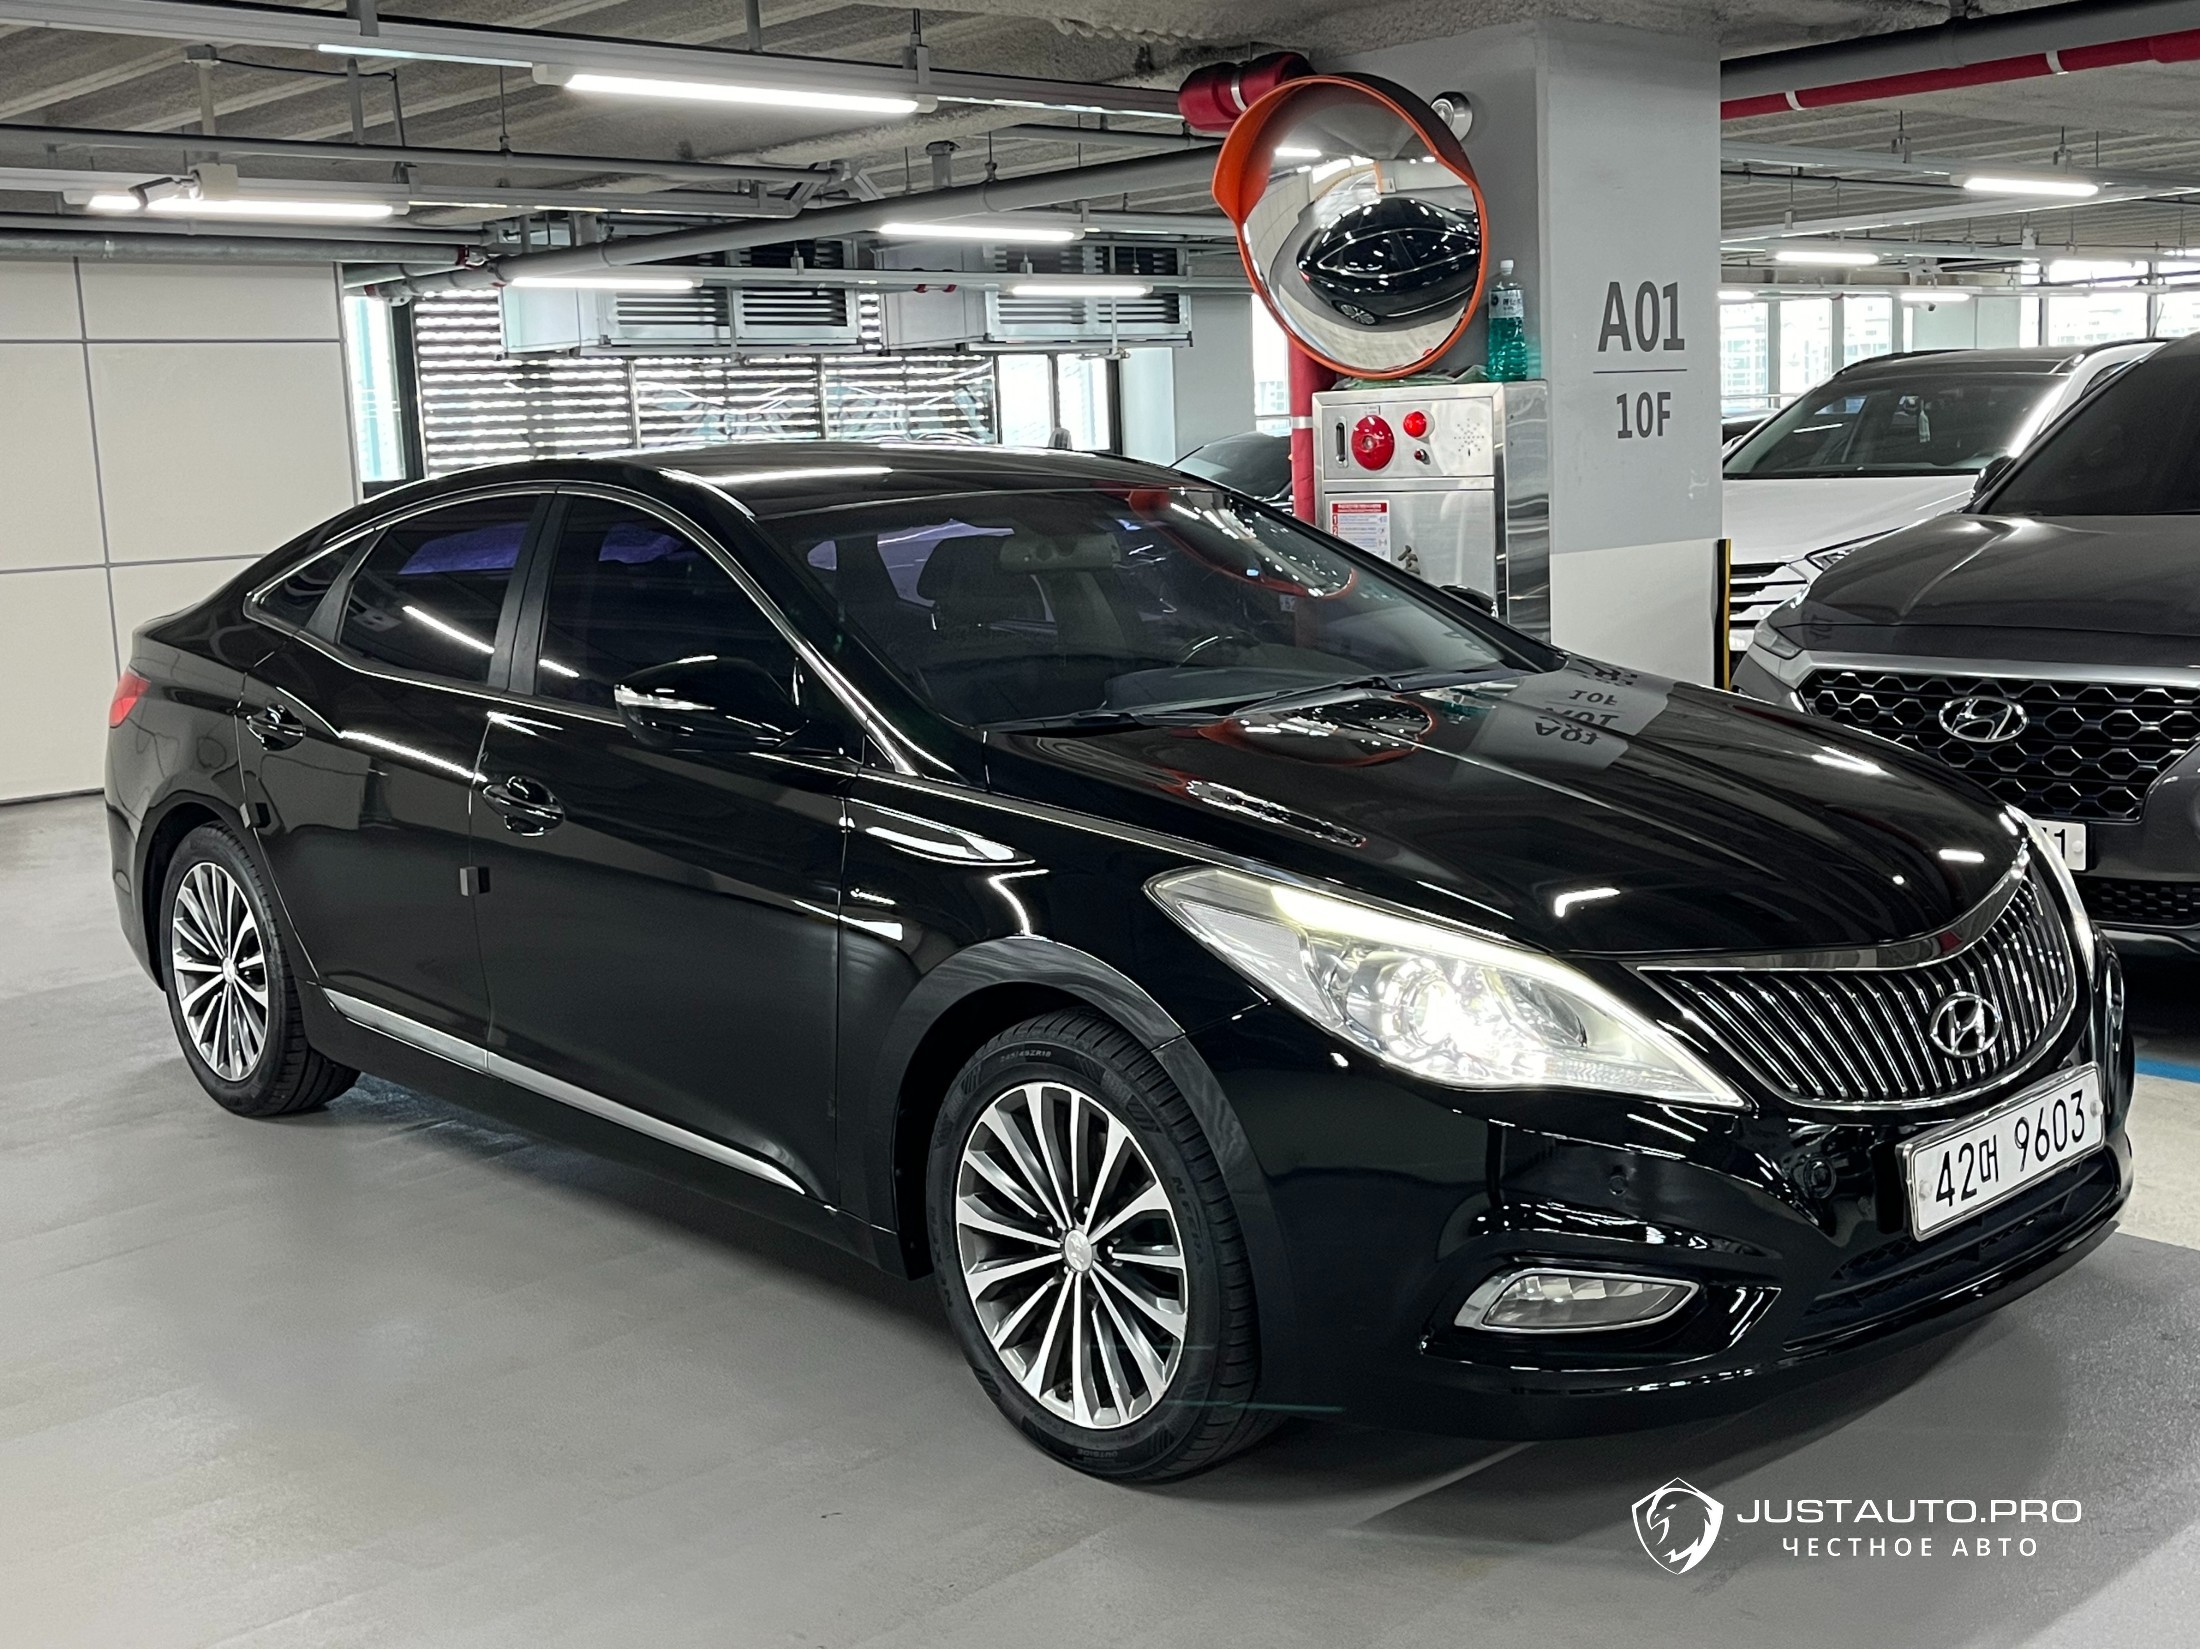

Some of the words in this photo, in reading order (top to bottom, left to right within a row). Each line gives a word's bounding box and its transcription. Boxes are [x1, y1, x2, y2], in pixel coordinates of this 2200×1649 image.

[1597, 281, 1685, 352] A01
[1616, 391, 1671, 439] 10F
[2014, 1089, 2086, 1173] 9603
